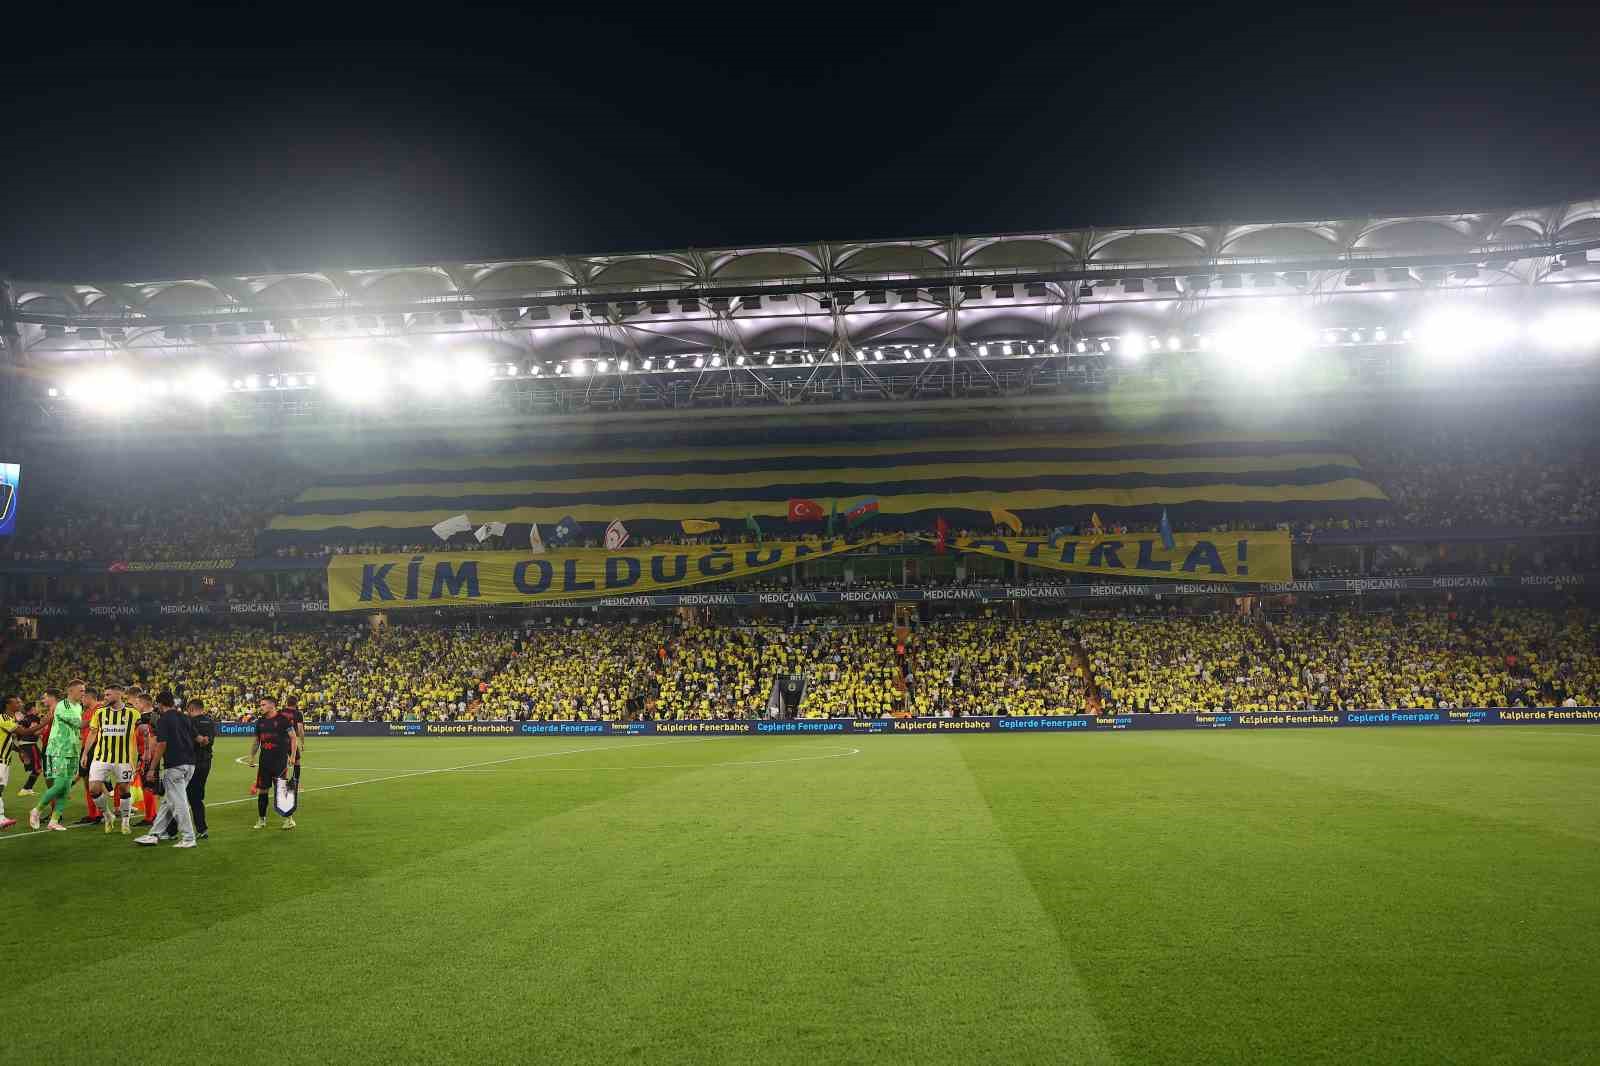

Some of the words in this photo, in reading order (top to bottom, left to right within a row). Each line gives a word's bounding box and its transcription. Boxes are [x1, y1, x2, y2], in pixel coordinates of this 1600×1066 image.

[359, 556, 481, 602] KİM
[1432, 577, 1487, 588] MEDICANA
[1521, 575, 1577, 586] MEDICANA
[1175, 584, 1228, 593] MEDICANA
[1259, 583, 1313, 593] MEDICANA
[1346, 580, 1400, 590] MEDICANA
[840, 591, 892, 601] MEDICANA
[923, 589, 975, 600] MEDICANA
[1006, 588, 1059, 598] MEDICANA
[1090, 586, 1144, 596] MEDICANA
[600, 597, 649, 606] MEDICANA
[679, 595, 729, 604] MEDICANA
[759, 593, 809, 602] MEDICANA
[160, 604, 204, 615] MEDICANA
[230, 603, 275, 613] MEDICANA
[302, 601, 329, 612] MEDIC
[1239, 715, 1283, 725] Kalplerde
[1286, 714, 1339, 725] Fenerbahçe
[1348, 713, 1389, 723] Ceplerde
[1392, 712, 1440, 722] Fenerpara
[1499, 711, 1546, 721] Kalplerde
[1548, 710, 1600, 720] Fenerbahç
[428, 724, 465, 733] Kalplerde
[467, 724, 514, 734] Fenerbahçe
[521, 724, 560, 733] Ceplerde
[560, 723, 604, 733] Fenerpara
[656, 723, 697, 733] Kalplerde
[700, 723, 750, 733] Fenerbahçe
[757, 722, 796, 732] Ceplerde
[798, 722, 843, 732] Fenerpara
[894, 720, 937, 731] Kalplerde
[939, 720, 991, 730] Fenerbahçe
[999, 719, 1039, 729] Ceplerde
[1041, 719, 1087, 729] Fenerpara
